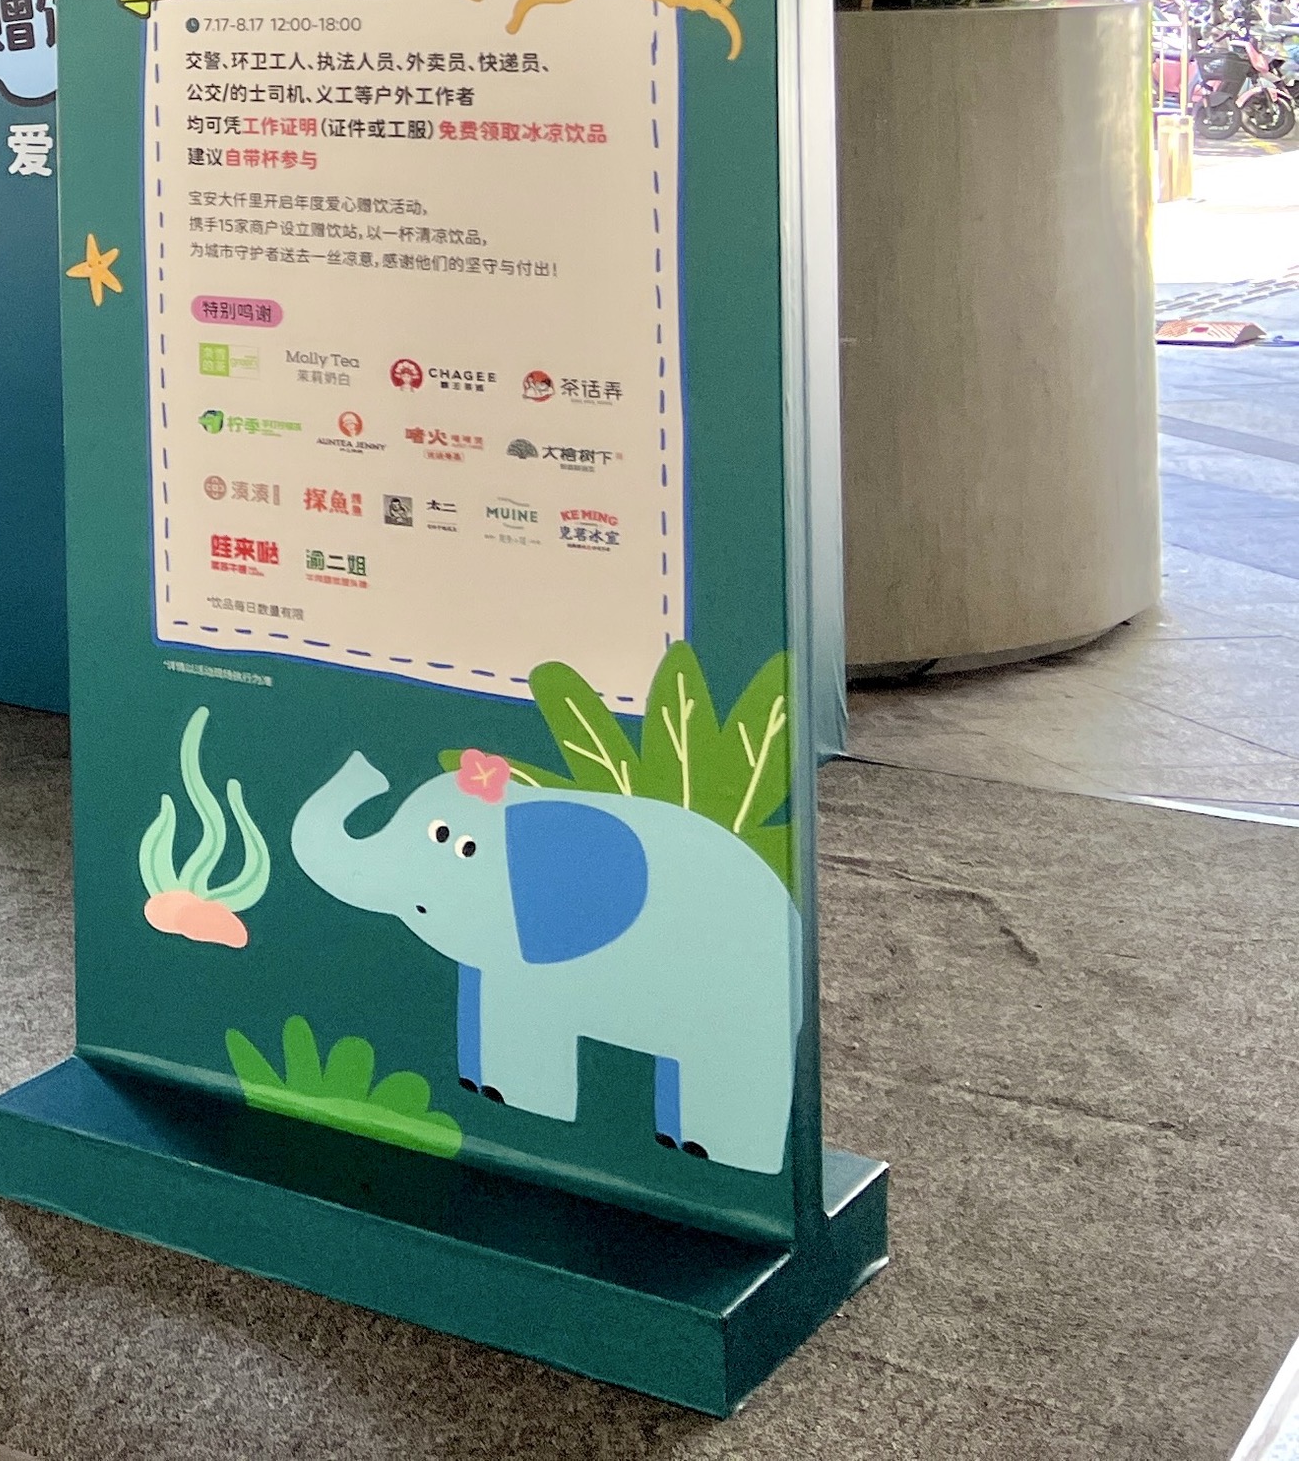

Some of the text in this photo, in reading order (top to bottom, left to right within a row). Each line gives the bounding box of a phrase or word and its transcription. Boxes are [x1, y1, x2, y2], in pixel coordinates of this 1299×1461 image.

[204, 18, 362, 32] 7.17-8.17 12:00-18:00
[185, 51, 550, 73] 交警、环卫工人、执法人员、外卖员、快递员、
[186, 84, 475, 107] 公交/的士司机、义工等户外工作者
[8, 123, 53, 177] 爱
[187, 148, 318, 170] 建议自带杯参与
[203, 301, 272, 323] 特别鸣谢
[286, 350, 360, 368] Molly Tea
[428, 368, 497, 383] CHAGEE
[426, 499, 457, 513] 太二
[486, 506, 538, 523] MUINE
